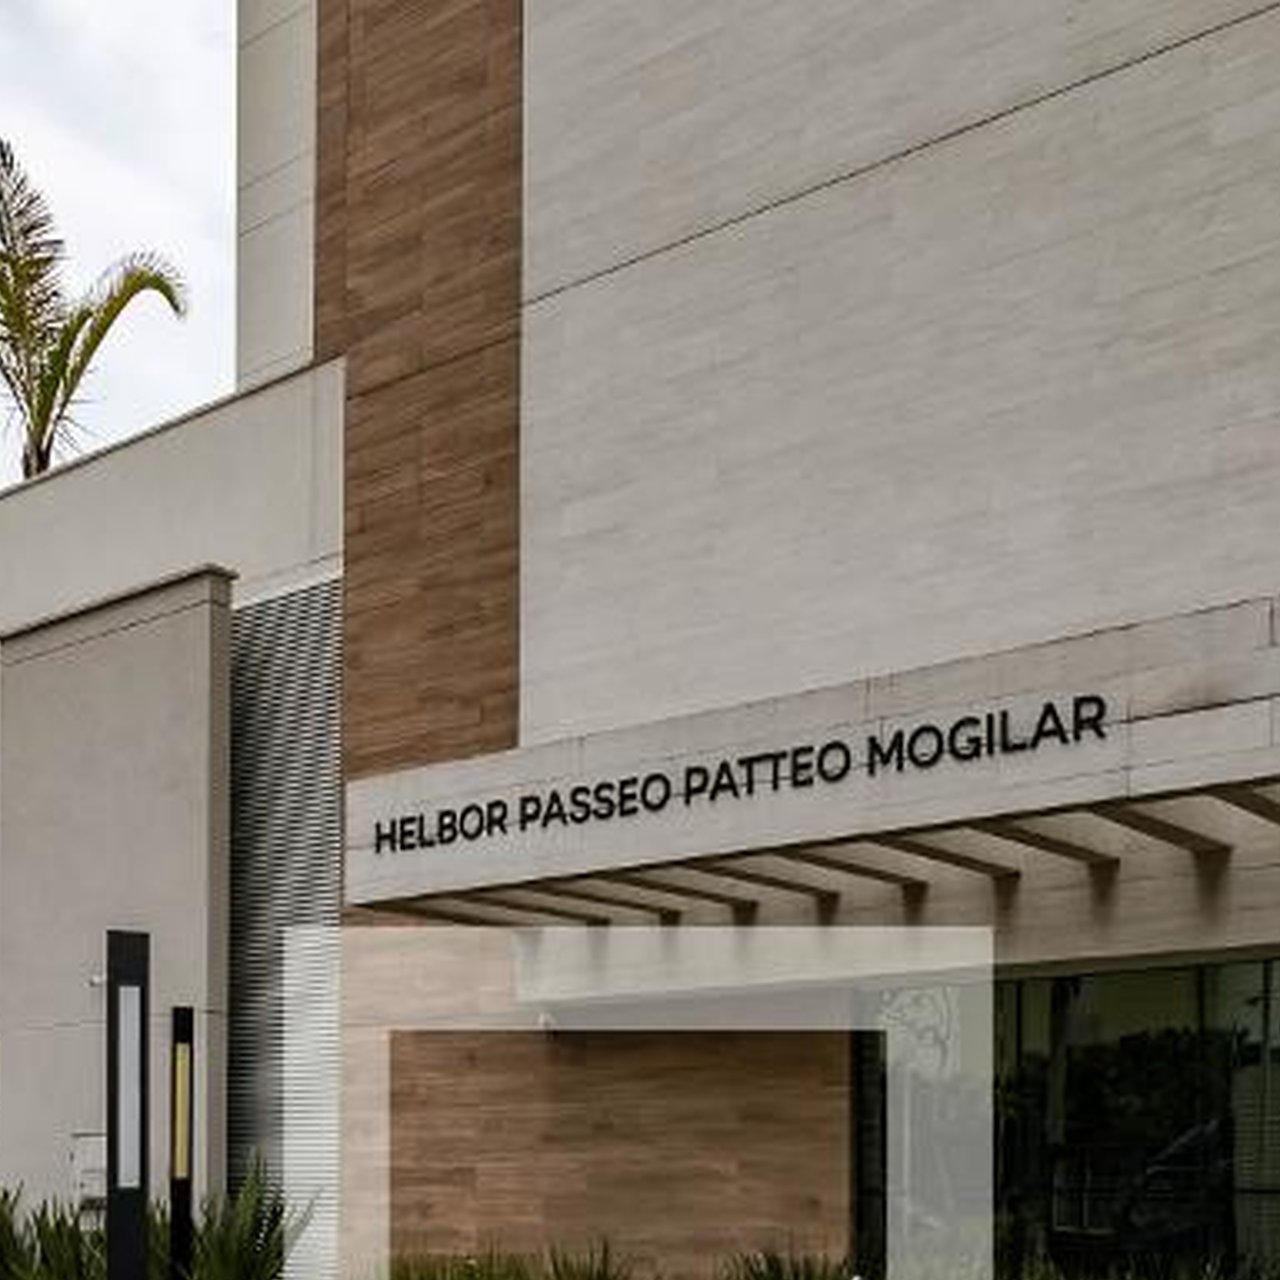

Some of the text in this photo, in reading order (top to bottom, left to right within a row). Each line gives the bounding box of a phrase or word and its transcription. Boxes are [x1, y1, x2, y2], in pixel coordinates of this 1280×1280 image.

[375, 694, 1107, 853] HELBOR PASSEO PATTEO MOGILAR
